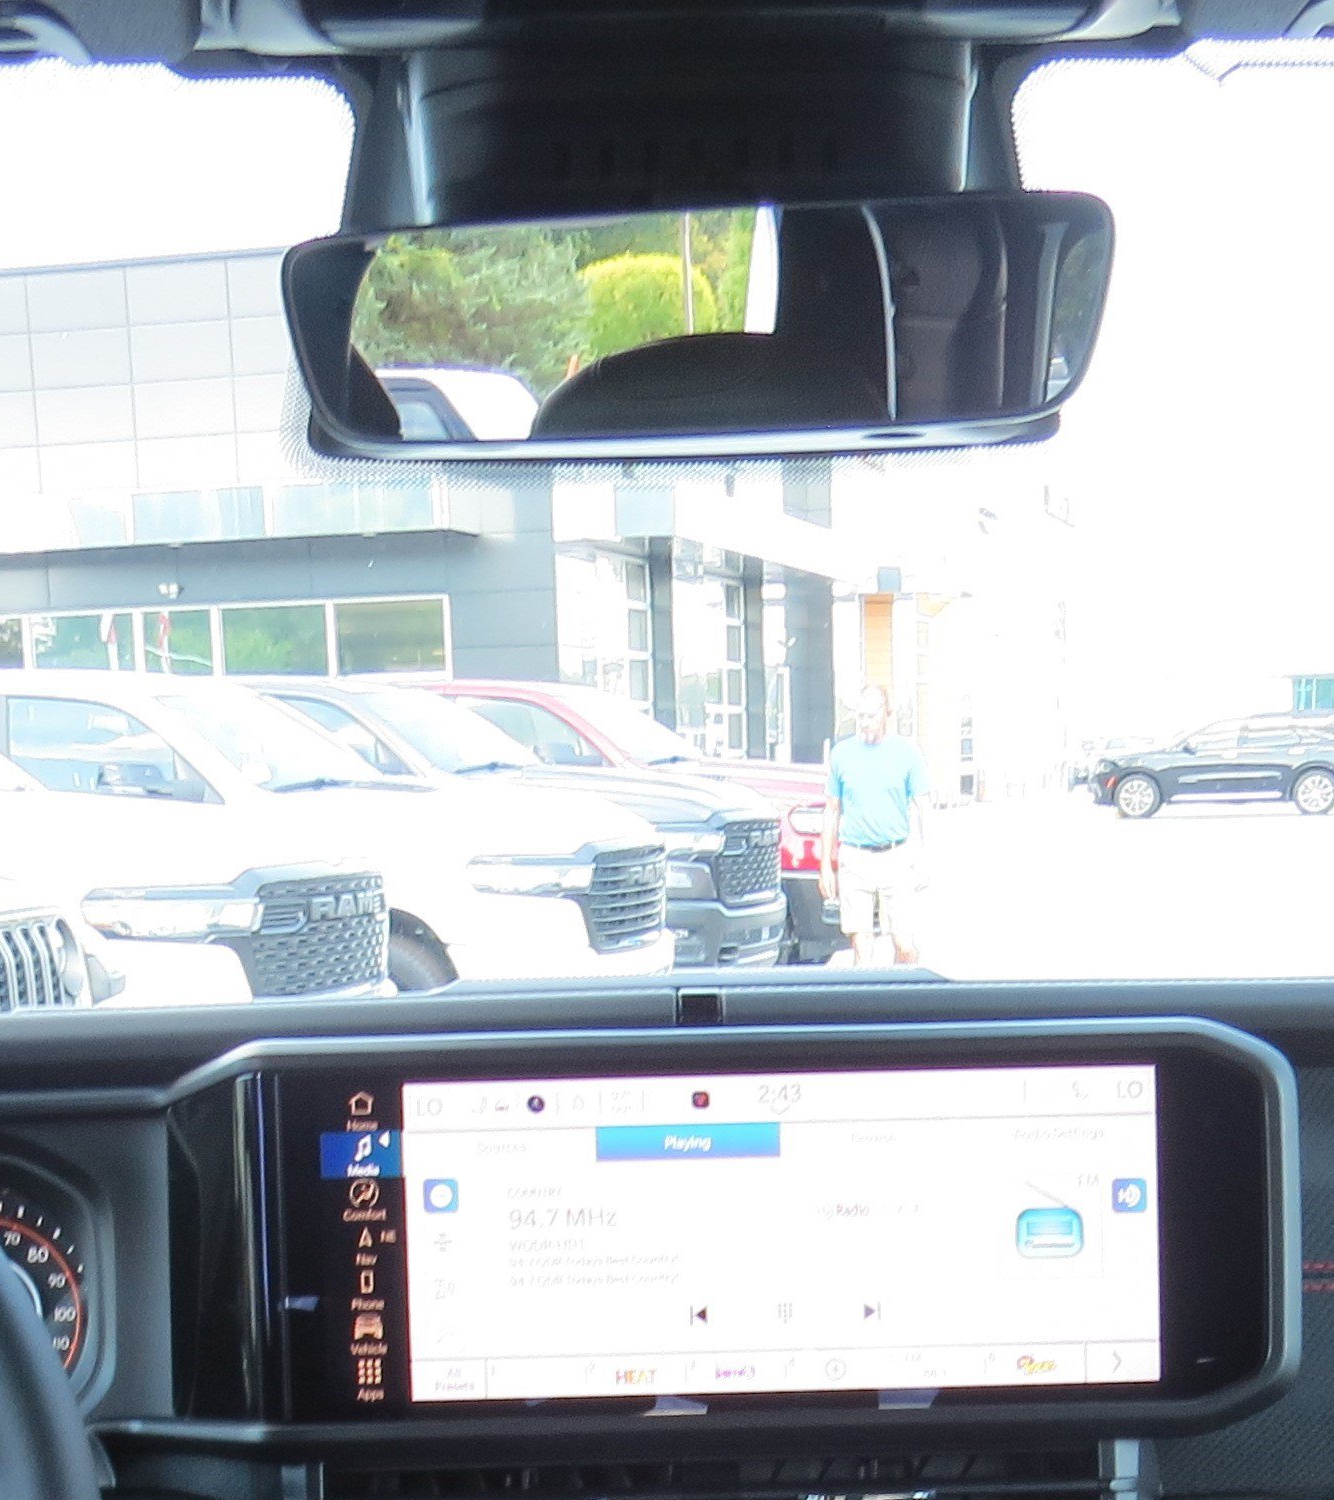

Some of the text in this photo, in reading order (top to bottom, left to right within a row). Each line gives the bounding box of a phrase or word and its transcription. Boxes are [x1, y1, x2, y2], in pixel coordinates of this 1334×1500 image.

[311, 891, 373, 922] RAM
[757, 1083, 802, 1104] 2:43
[346, 1119, 379, 1132] Home
[664, 1134, 712, 1152] Playing
[347, 1162, 381, 1177] Media
[342, 1208, 388, 1222] Comfort
[508, 1207, 618, 1230] 94.7 MHz
[3, 1231, 22, 1247] 70
[27, 1246, 50, 1264] 80
[355, 1252, 379, 1267] Nav
[47, 1273, 66, 1289] 90
[351, 1298, 386, 1312] Phone
[53, 1306, 77, 1322] 100
[351, 1342, 389, 1356] Vehicle
[357, 1387, 386, 1403] Apps
